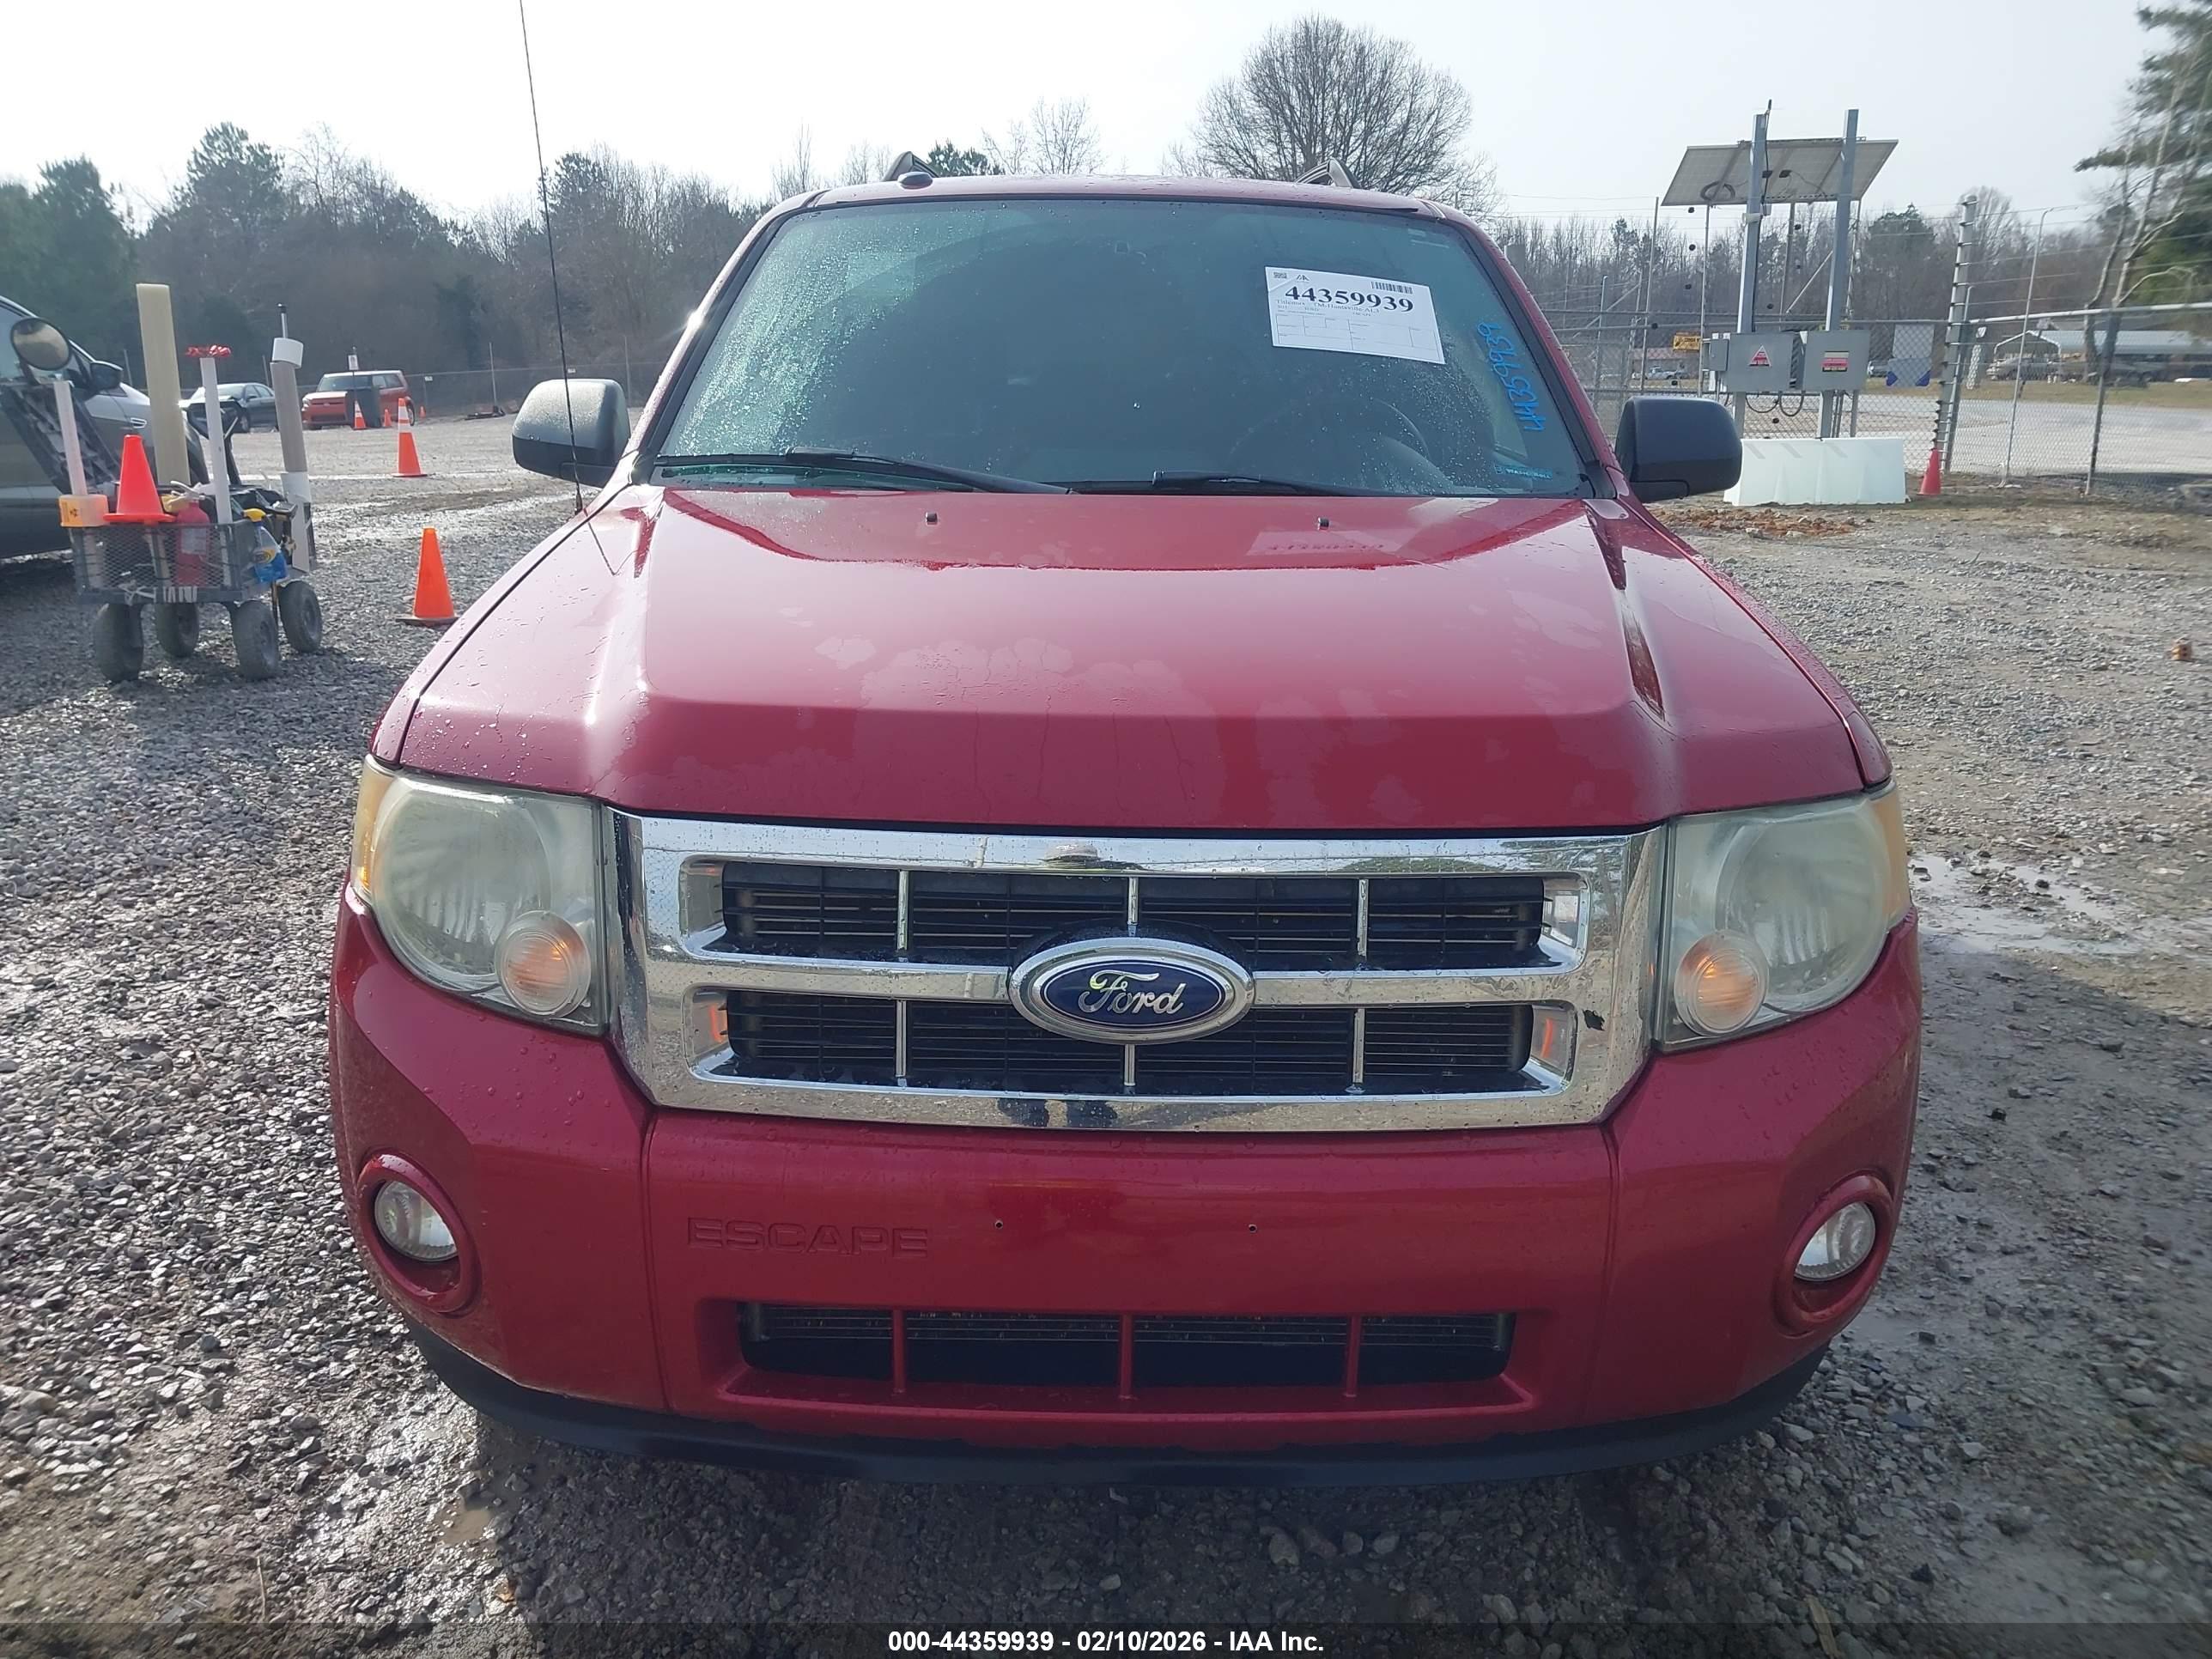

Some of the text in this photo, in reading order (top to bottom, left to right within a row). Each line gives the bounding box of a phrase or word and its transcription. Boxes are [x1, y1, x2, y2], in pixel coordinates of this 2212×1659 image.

[1285, 285, 1414, 313] 44359939
[1477, 321, 1547, 432] 44359939
[1078, 969, 1187, 1015] Ford
[687, 1217, 928, 1258] ESCAPE
